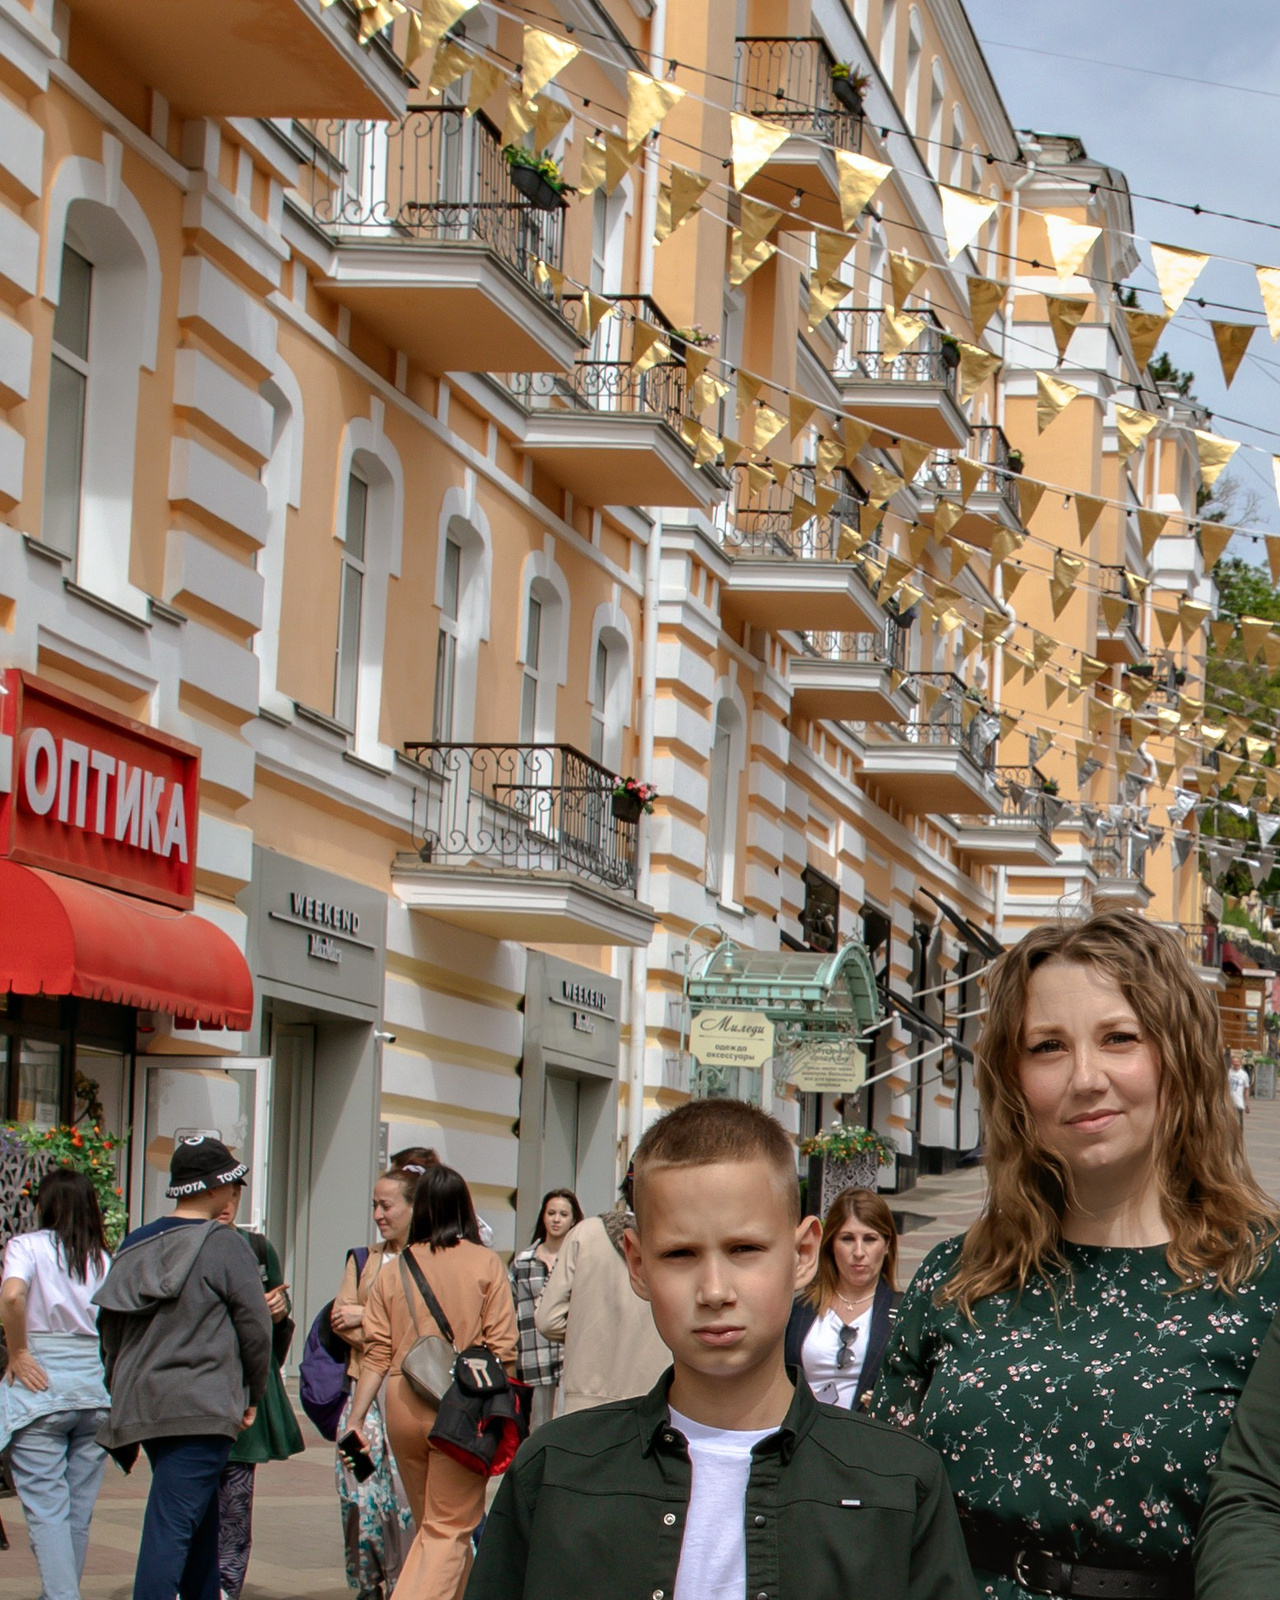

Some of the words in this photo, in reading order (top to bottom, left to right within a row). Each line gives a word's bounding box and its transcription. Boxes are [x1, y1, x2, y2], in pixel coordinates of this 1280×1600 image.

[24, 727, 188, 864] ОПТИКА
[290, 892, 360, 934] WEEKEND
[563, 981, 607, 1010] WEEKEND
[700, 1015, 765, 1037] Миледи
[169, 1180, 206, 1197] TOYOTA
